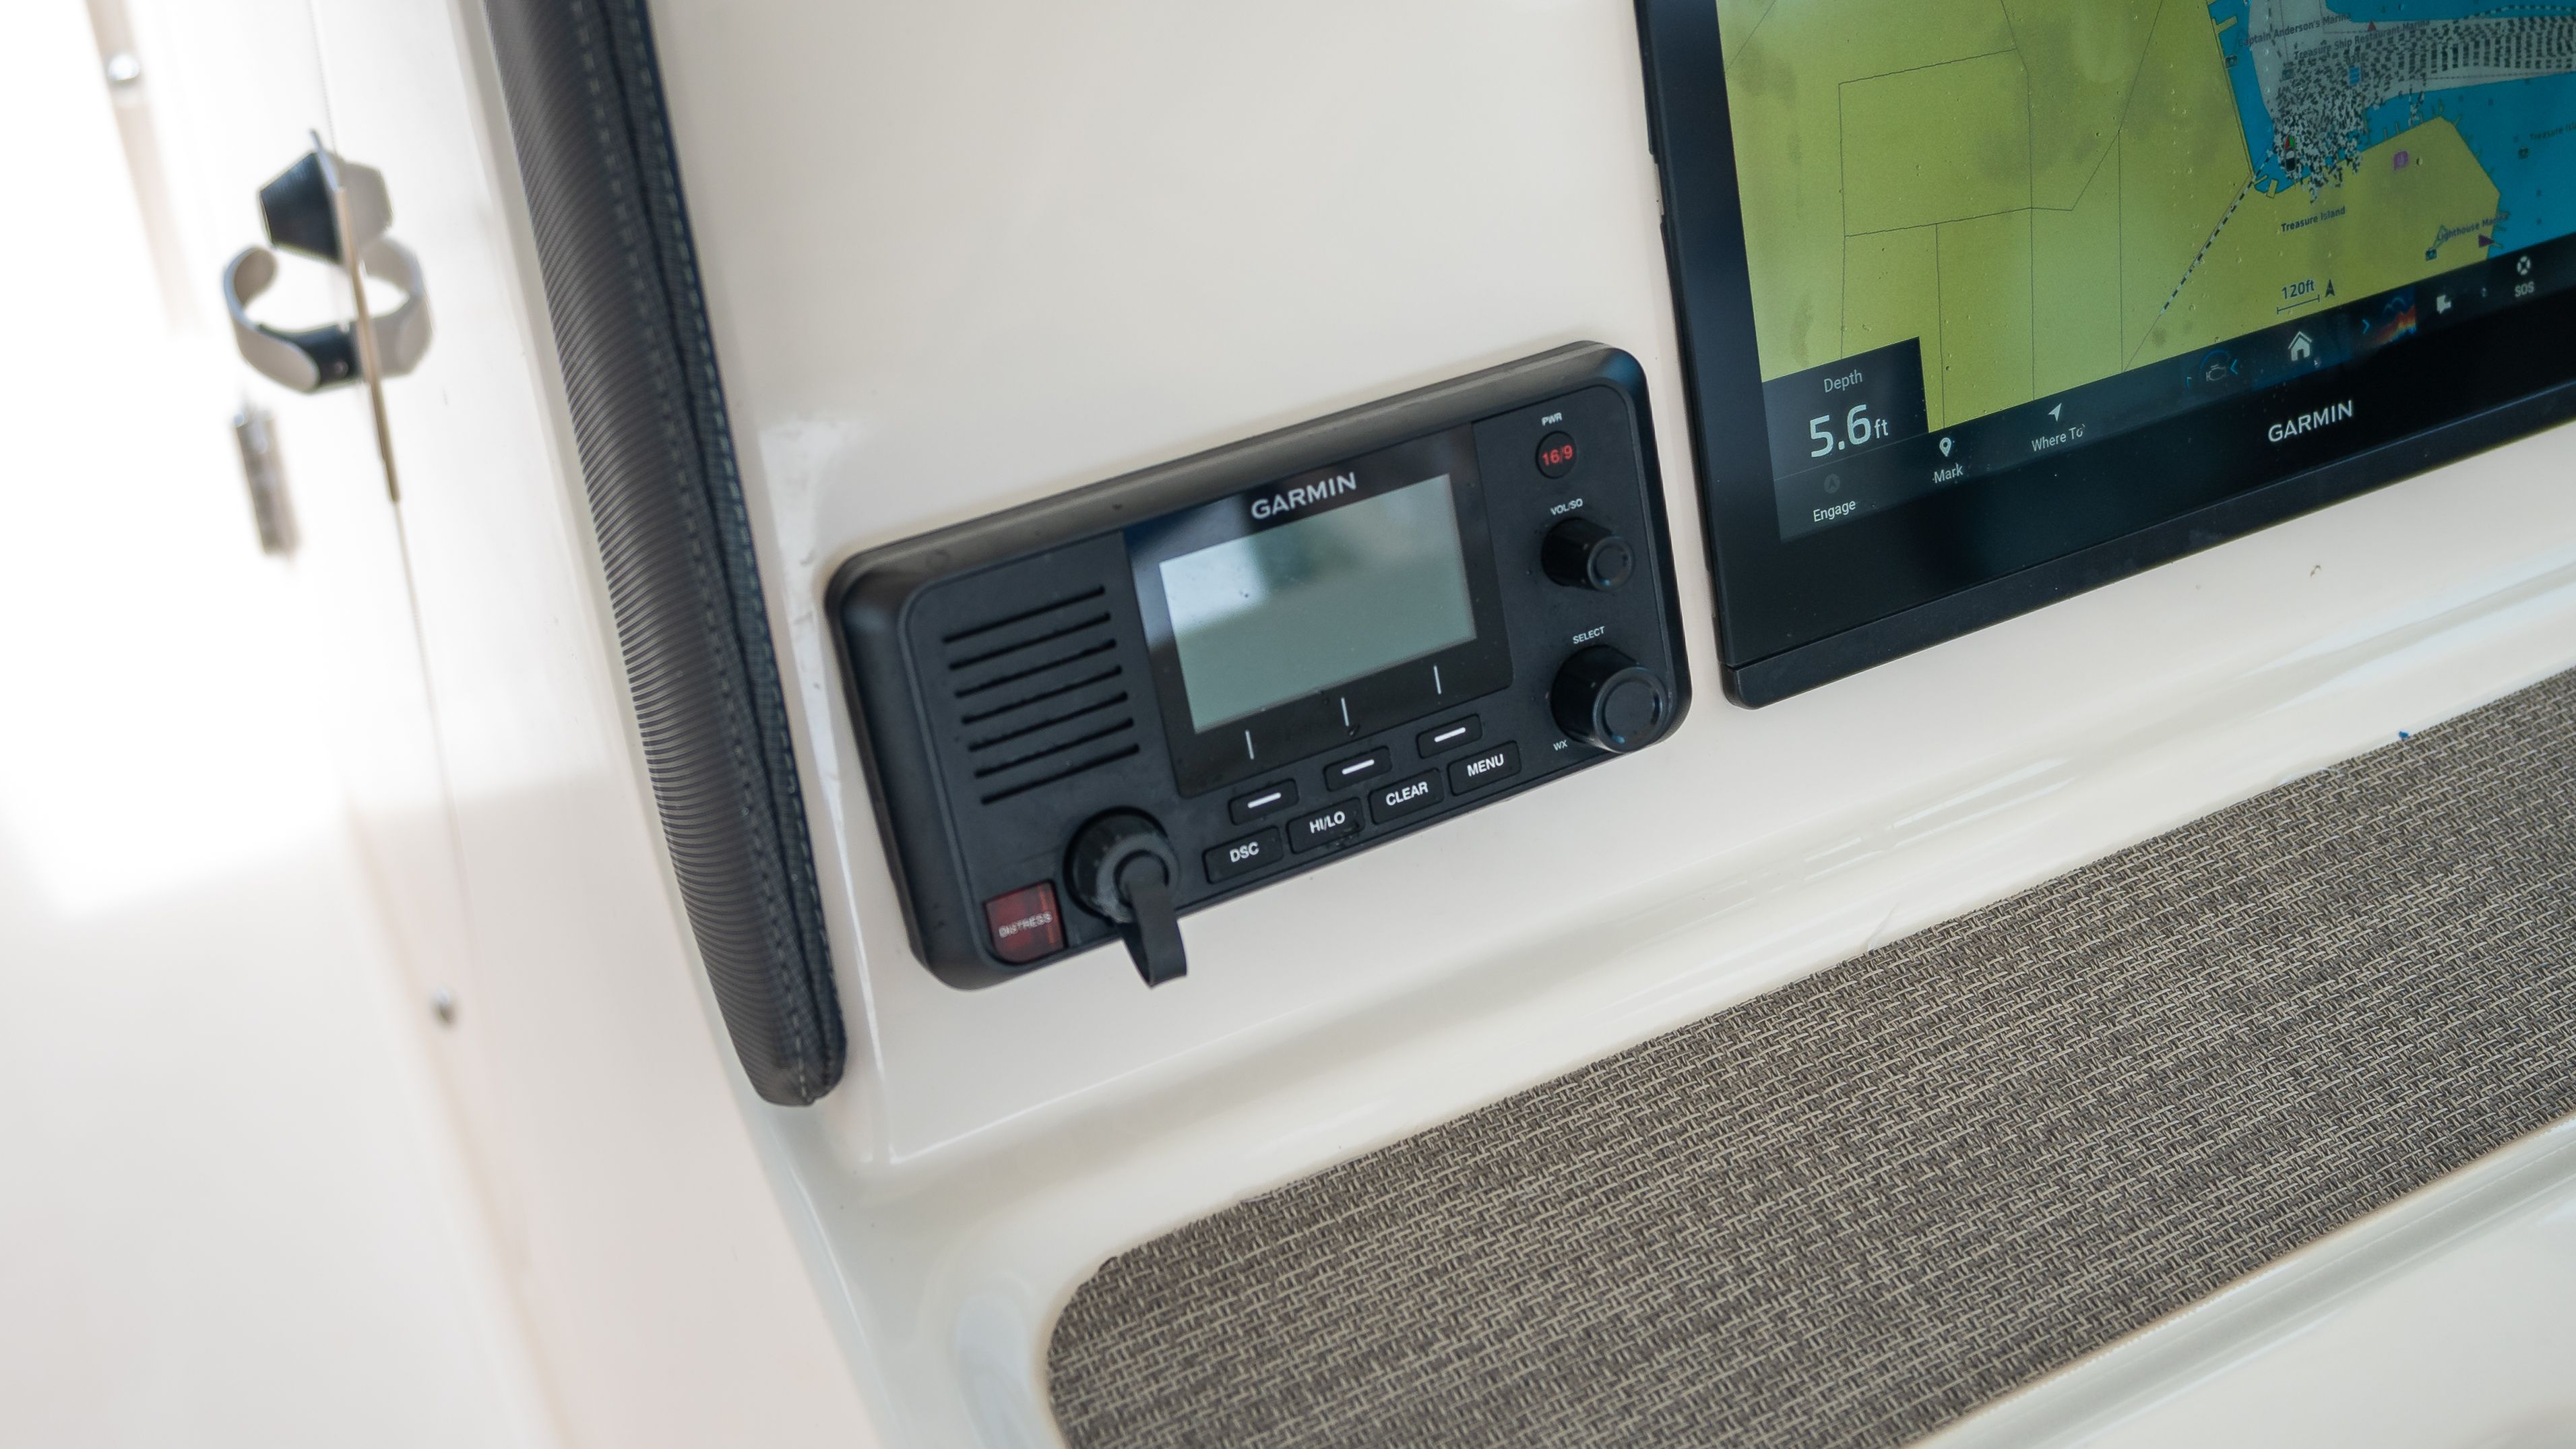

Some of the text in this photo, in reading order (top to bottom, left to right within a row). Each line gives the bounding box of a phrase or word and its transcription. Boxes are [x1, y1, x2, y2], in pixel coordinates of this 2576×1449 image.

[2238, 13, 2352, 47] Captain Anderson's Marina
[2294, 44, 2331, 60] Treasure
[2333, 39, 2352, 51] Ship
[2354, 26, 2401, 44] Restaurant
[2403, 20, 2430, 32] Marina
[2281, 206, 2346, 232] Treasure Island
[2437, 222, 2480, 242] Lighthouse
[2281, 279, 2315, 300] 120ft
[2515, 281, 2535, 297] SOS
[1824, 369, 1863, 393] Depth
[1541, 412, 1563, 426] PWR
[1810, 404, 1889, 458] 5.6 ft
[2268, 399, 2354, 442] GARMIN
[2031, 428, 2083, 452] Where To
[1542, 444, 1573, 466] 16/9
[1934, 462, 1964, 484] Mark
[1251, 471, 1357, 520] GARMIN
[1813, 501, 1856, 523] Engage
[1572, 626, 1605, 644] SELECT
[1553, 740, 1568, 751] WX
[1466, 753, 1505, 777] MENU
[1385, 781, 1429, 806] CLEAR
[1309, 810, 1346, 834] HI/LO
[1229, 841, 1260, 863] DSC
[999, 911, 1053, 938] DISTRESS
